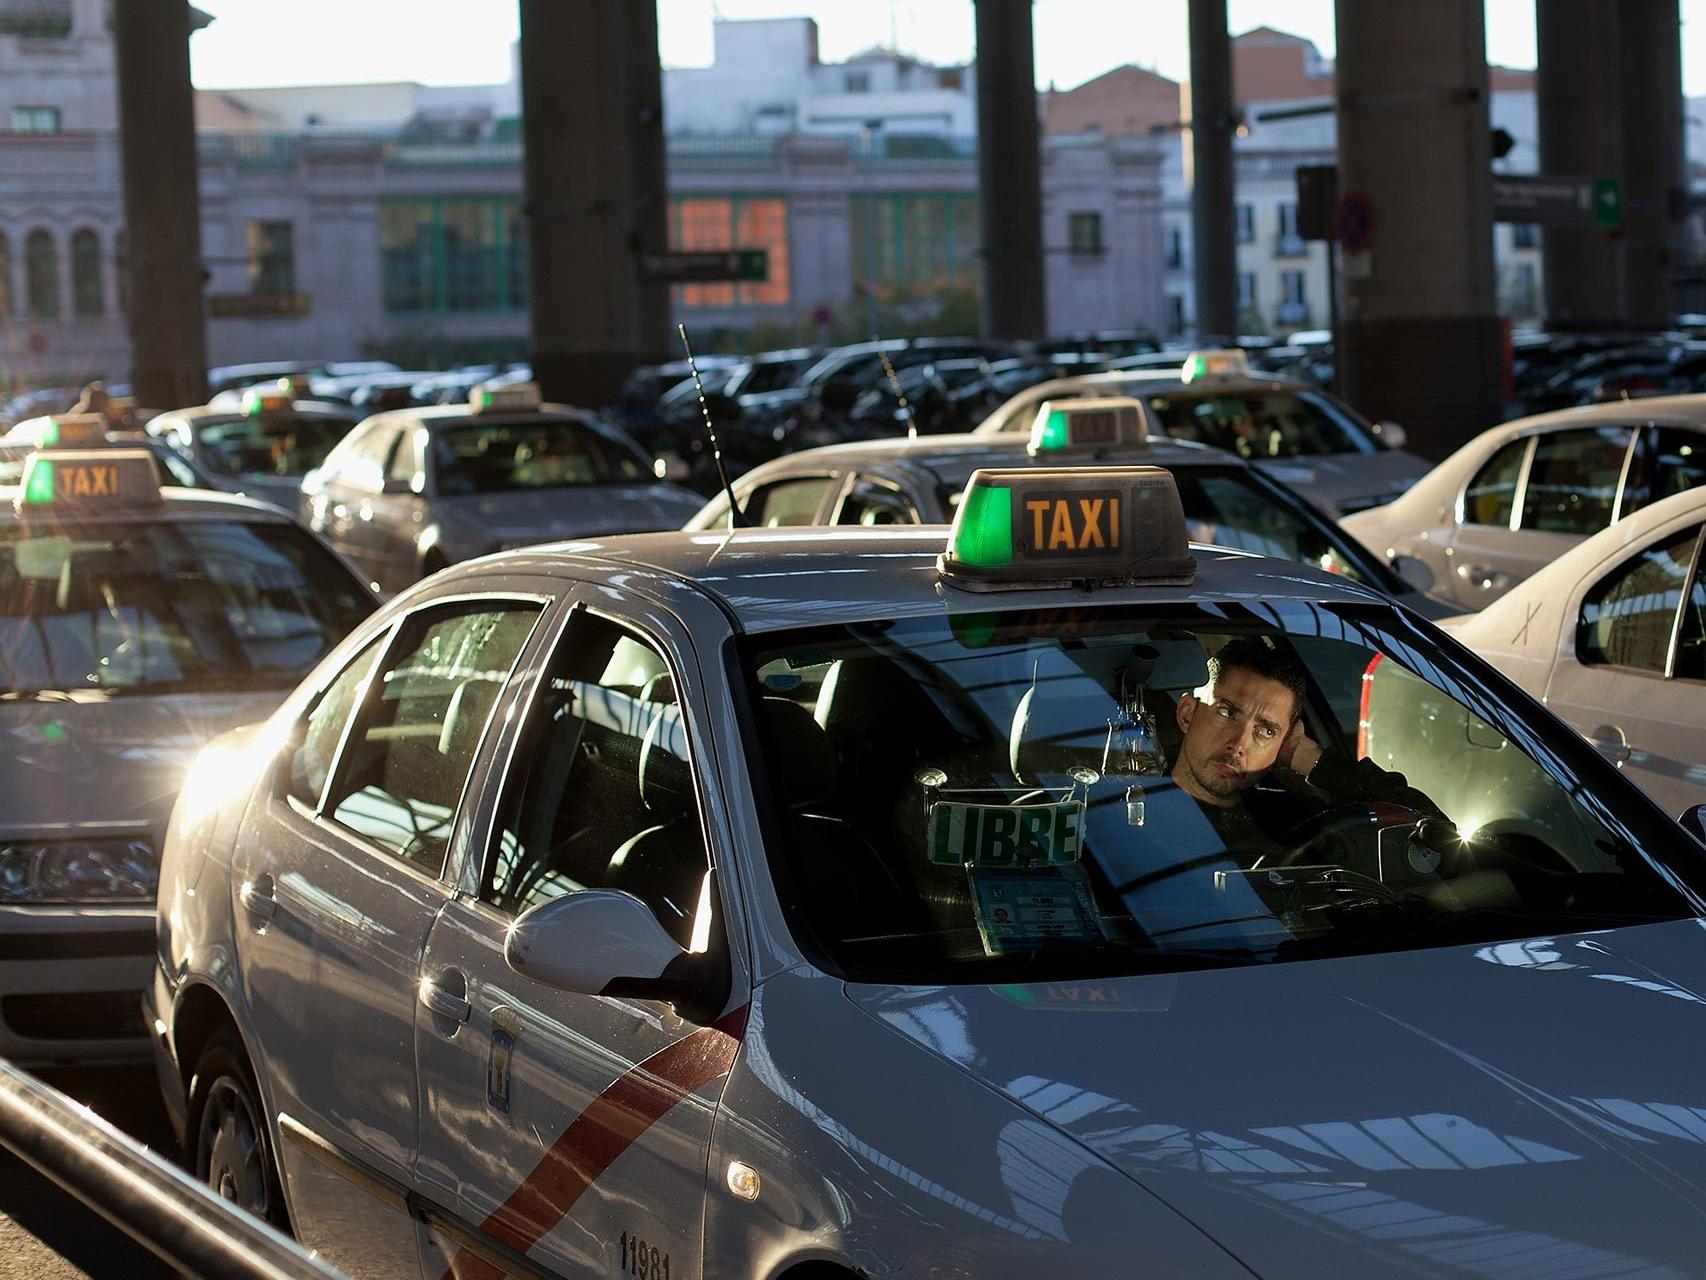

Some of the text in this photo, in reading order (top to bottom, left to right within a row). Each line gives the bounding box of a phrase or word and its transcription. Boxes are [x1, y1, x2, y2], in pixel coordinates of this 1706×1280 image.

[60, 466, 119, 497] TAXI
[1026, 499, 1119, 550] TAXI
[934, 803, 1080, 865] LIBRE
[620, 1230, 670, 1280] 11981
